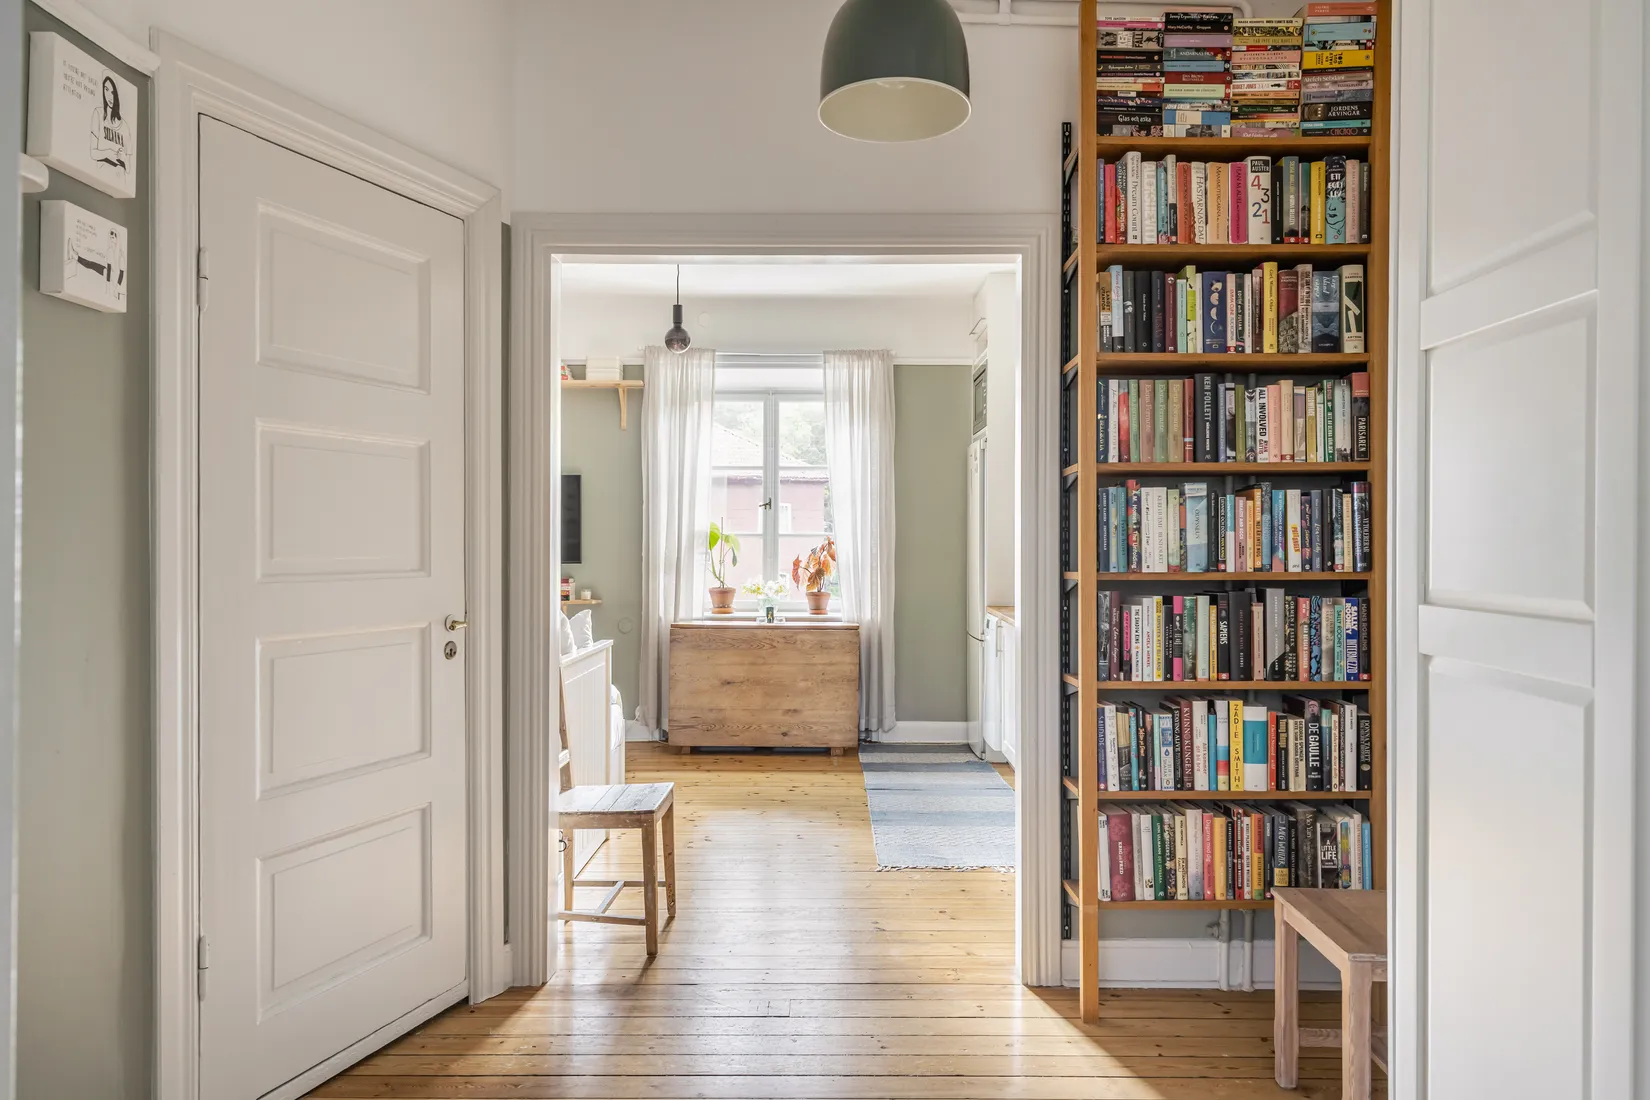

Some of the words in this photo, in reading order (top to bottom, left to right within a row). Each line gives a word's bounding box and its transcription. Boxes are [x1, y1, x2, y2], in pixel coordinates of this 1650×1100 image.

[1251, 175, 1261, 190] 4
[1261, 188, 1270, 203] 3
[1252, 202, 1262, 217] 2
[1262, 209, 1270, 224] 1
[1258, 402, 1267, 437] INVOLVED
[1358, 417, 1366, 452] PARISAREN
[1220, 621, 1228, 645] SAPIENS
[1308, 723, 1319, 734] DE
[1309, 735, 1320, 767] GAULLE
[1233, 748, 1241, 782] SMITH
[1306, 814, 1312, 825] Mo
[1321, 851, 1337, 860] LIFE
